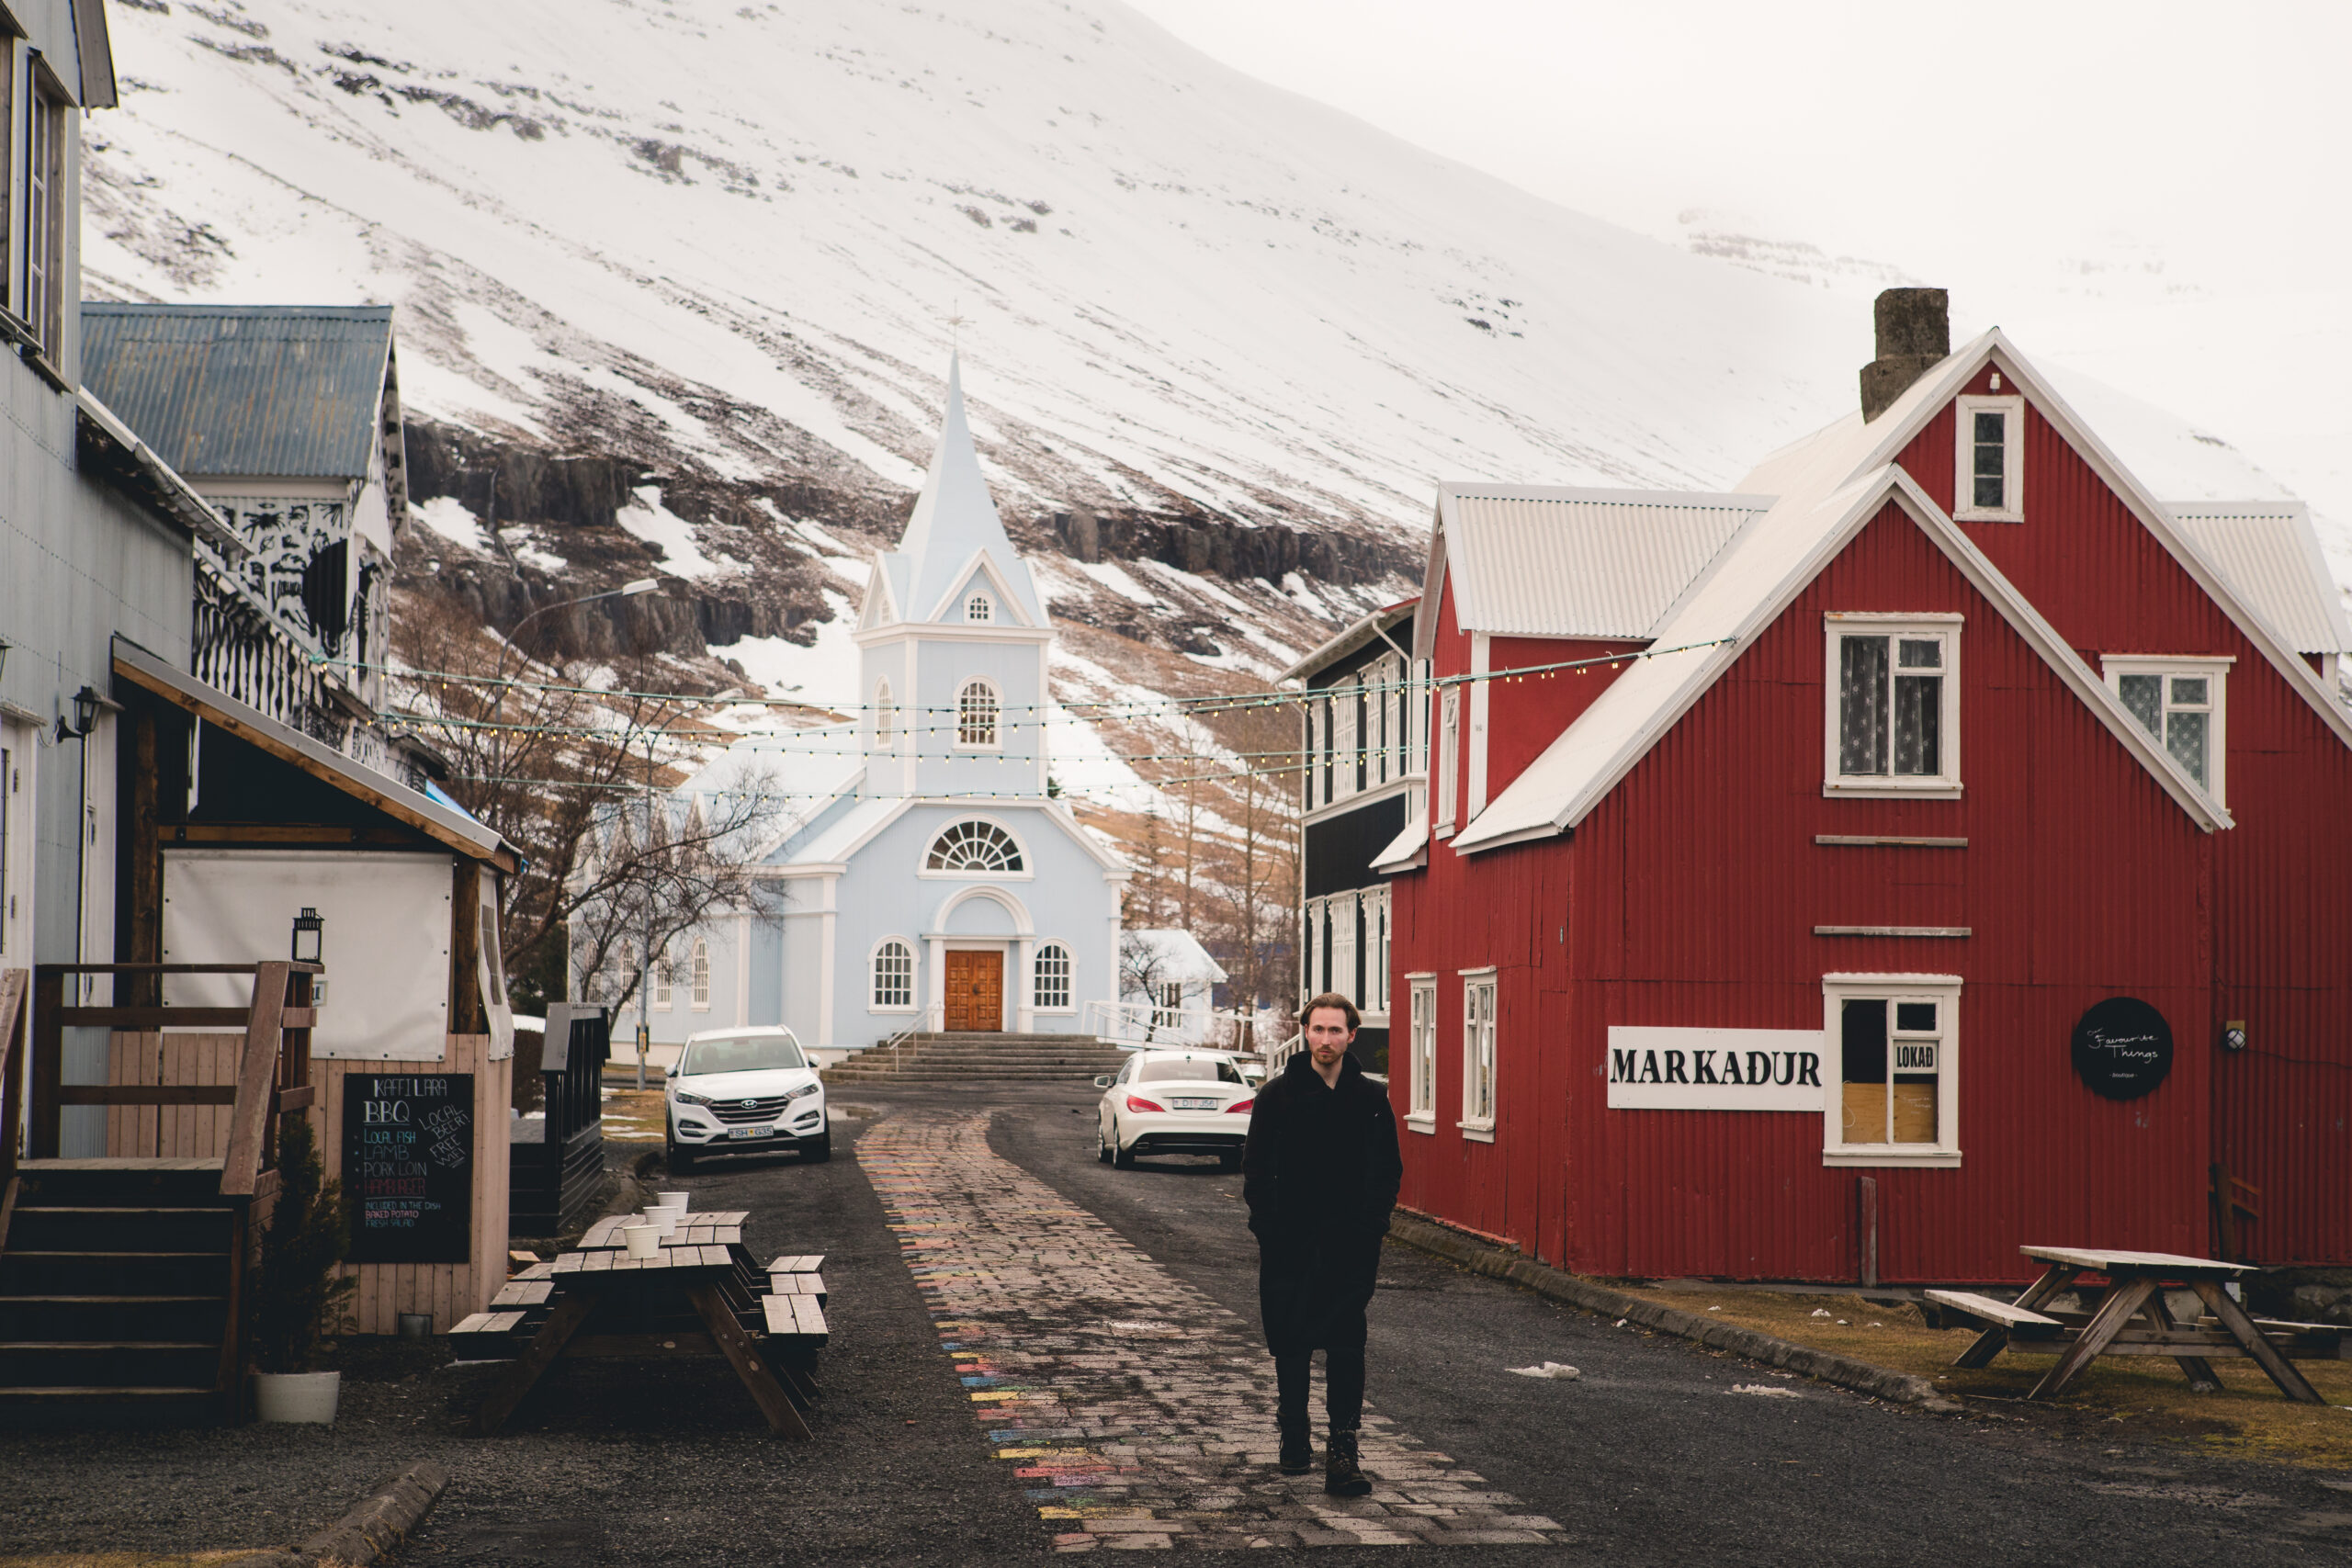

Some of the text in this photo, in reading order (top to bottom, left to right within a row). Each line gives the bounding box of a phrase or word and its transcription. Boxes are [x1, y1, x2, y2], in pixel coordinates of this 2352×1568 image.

[2087, 1034, 2159, 1050] Favourite
[1896, 1045, 1933, 1068] LOKAÐ
[2104, 1044, 2159, 1064] Things
[1610, 1048, 1822, 1088] MARKAÐUR
[374, 1078, 447, 1098] KAFFI LARA
[363, 1100, 410, 1122] BBQ
[418, 1103, 464, 1131] LOCAL
[432, 1113, 470, 1139] BEER!
[364, 1128, 416, 1144] LOCAL FISH
[429, 1134, 461, 1157] FREE
[364, 1145, 410, 1160] LAMB
[435, 1147, 467, 1166] WIFI
[364, 1161, 427, 1178] PORK LOIN
[364, 1178, 426, 1195] HAMBURGER
[365, 1210, 420, 1219] BAKED POTATO
[400, 1201, 407, 1210] IN
[408, 1201, 423, 1210] THE
[424, 1201, 441, 1210] DISH
[365, 1219, 388, 1228] FRESH
